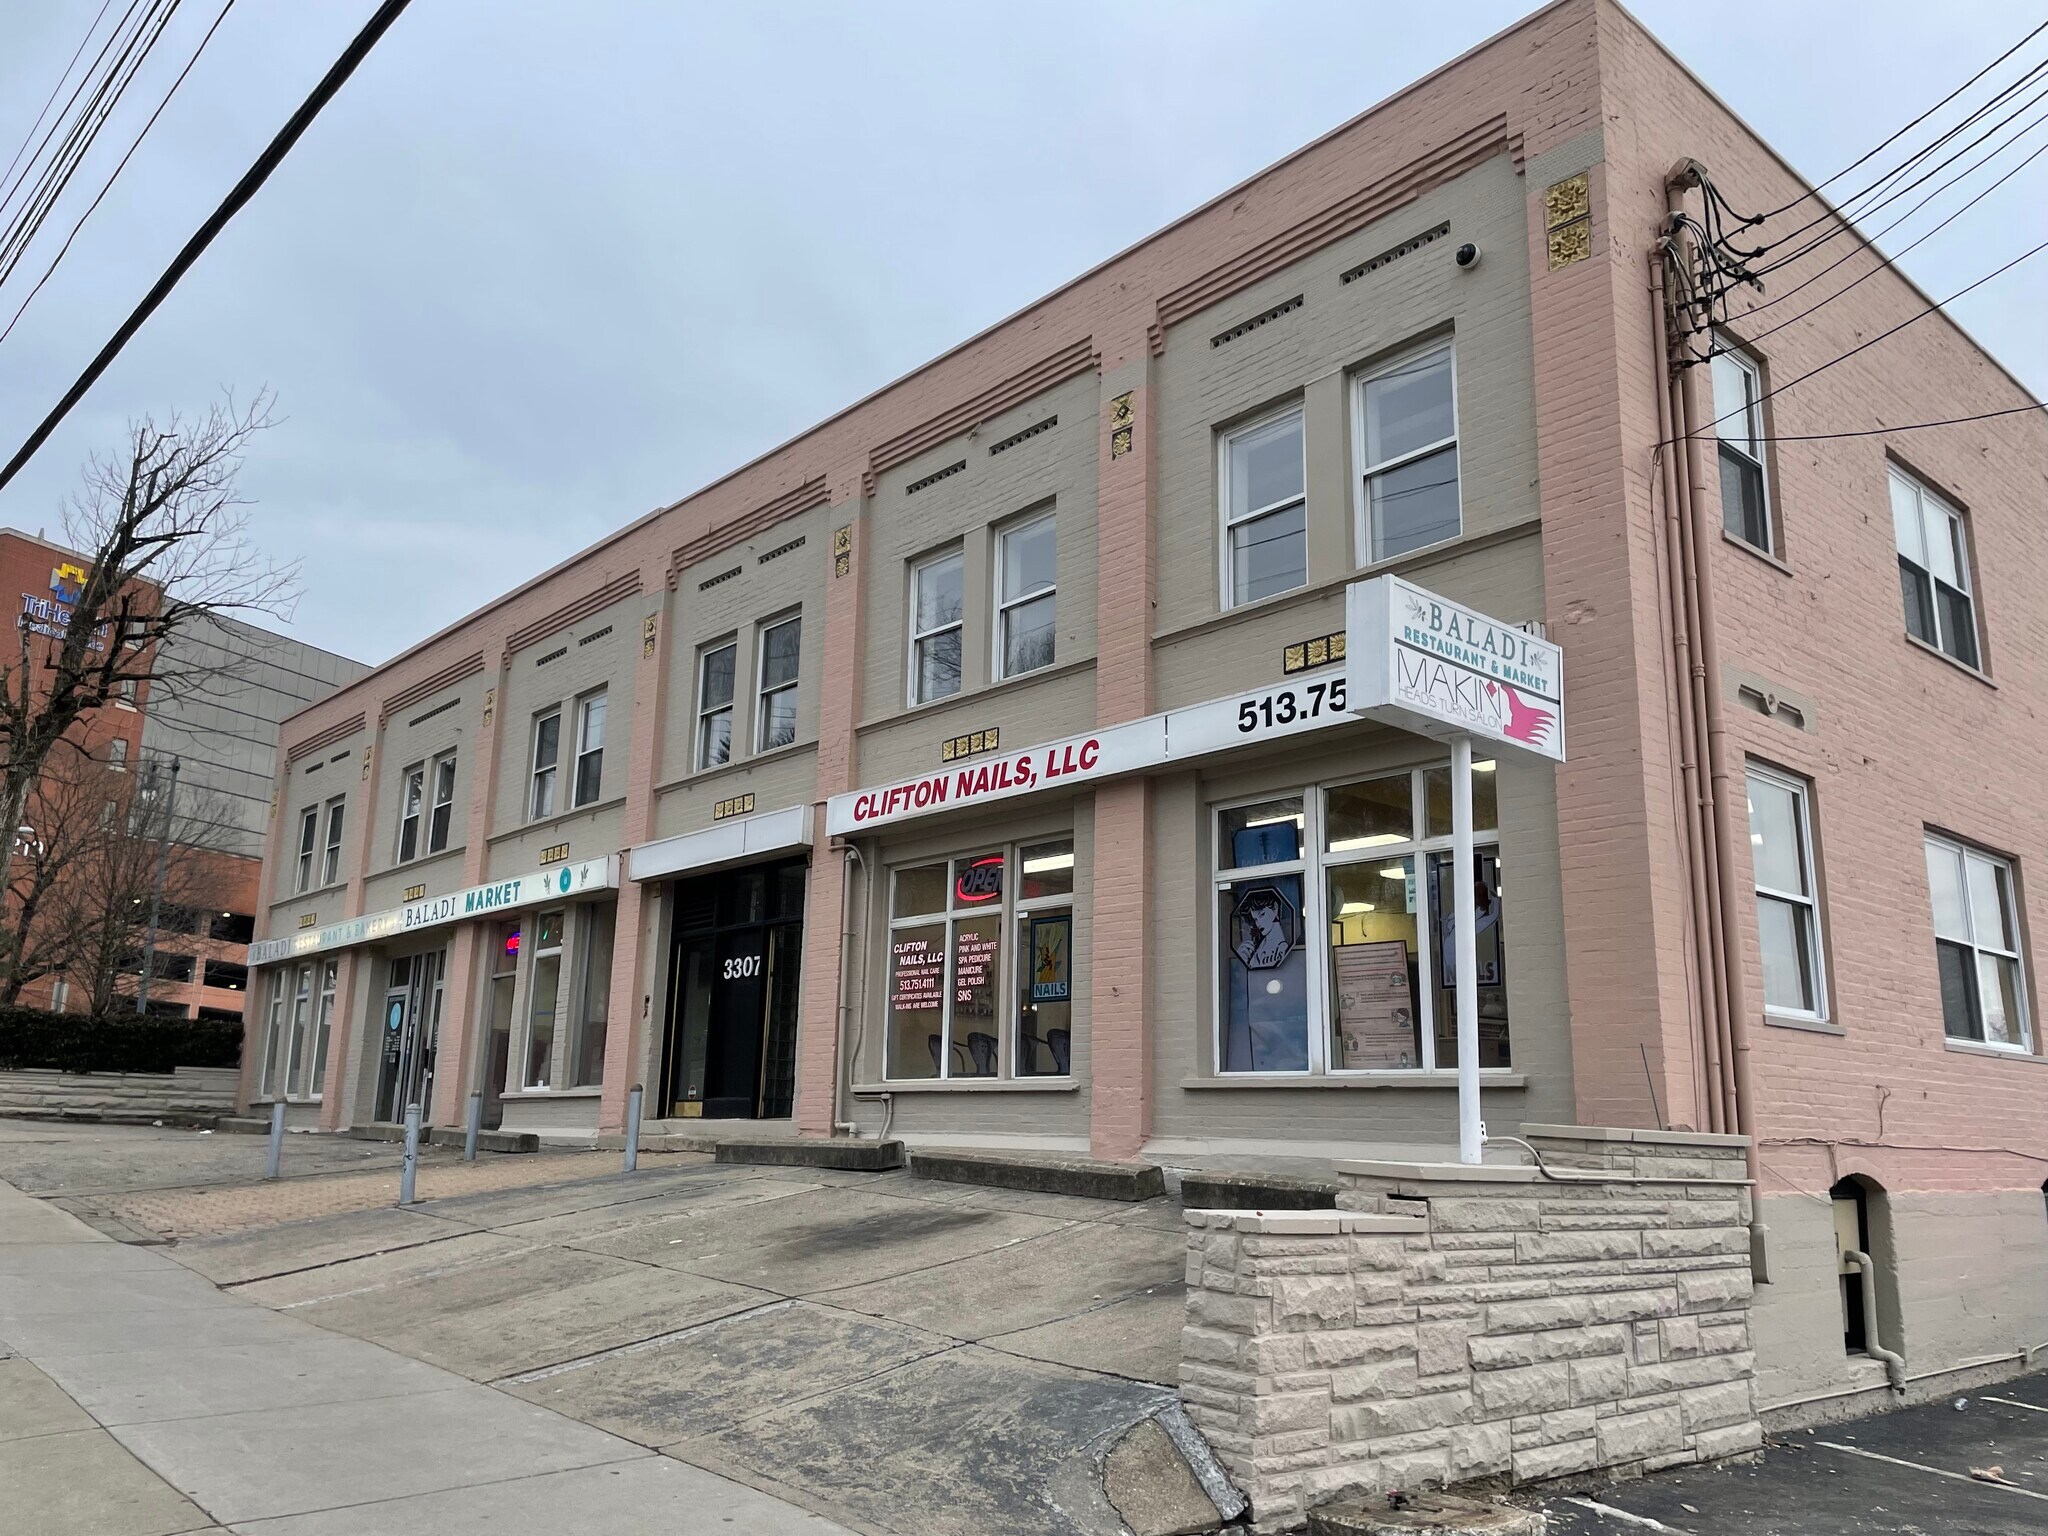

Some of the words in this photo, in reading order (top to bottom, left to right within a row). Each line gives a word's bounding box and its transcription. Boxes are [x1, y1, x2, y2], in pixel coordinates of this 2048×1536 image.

[1428, 602, 1528, 667] BALADI
[1404, 625, 1486, 669] RESTAURANT
[1490, 659, 1499, 675] &
[1503, 664, 1548, 692] MARKET
[1398, 683, 1437, 708] HEADS
[1439, 697, 1467, 719] TURN
[1469, 710, 1503, 731] SALON
[854, 776, 949, 821] CLIFTON
[956, 756, 1038, 799] NAILS,
[1045, 739, 1100, 778] LLC
[405, 897, 456, 927] BALADI
[465, 881, 521, 913] MARKET
[256, 937, 291, 961] BALADI
[294, 928, 342, 950] RESTAURANT
[355, 917, 389, 937] BAKERY
[959, 932, 979, 942] ACRYLIC
[894, 940, 928, 954] CLIFTON
[958, 944, 969, 953] PINK
[970, 943, 981, 952] AND
[982, 941, 997, 951] WHITE
[899, 954, 926, 966] NAILS,
[927, 951, 944, 963] LLC
[958, 955, 968, 965] SPA
[968, 953, 992, 963] PEDICURE
[1256, 946, 1284, 966] Nails
[723, 955, 761, 980] 3307
[957, 965, 983, 975] MANICURE
[957, 978, 967, 987] GEL
[967, 976, 985, 986] POLISH
[922, 990, 942, 999] AVAILABLE
[957, 989, 972, 1002] SNS
[1034, 982, 1066, 997] NAILS
[920, 1000, 939, 1009] WELCOME
